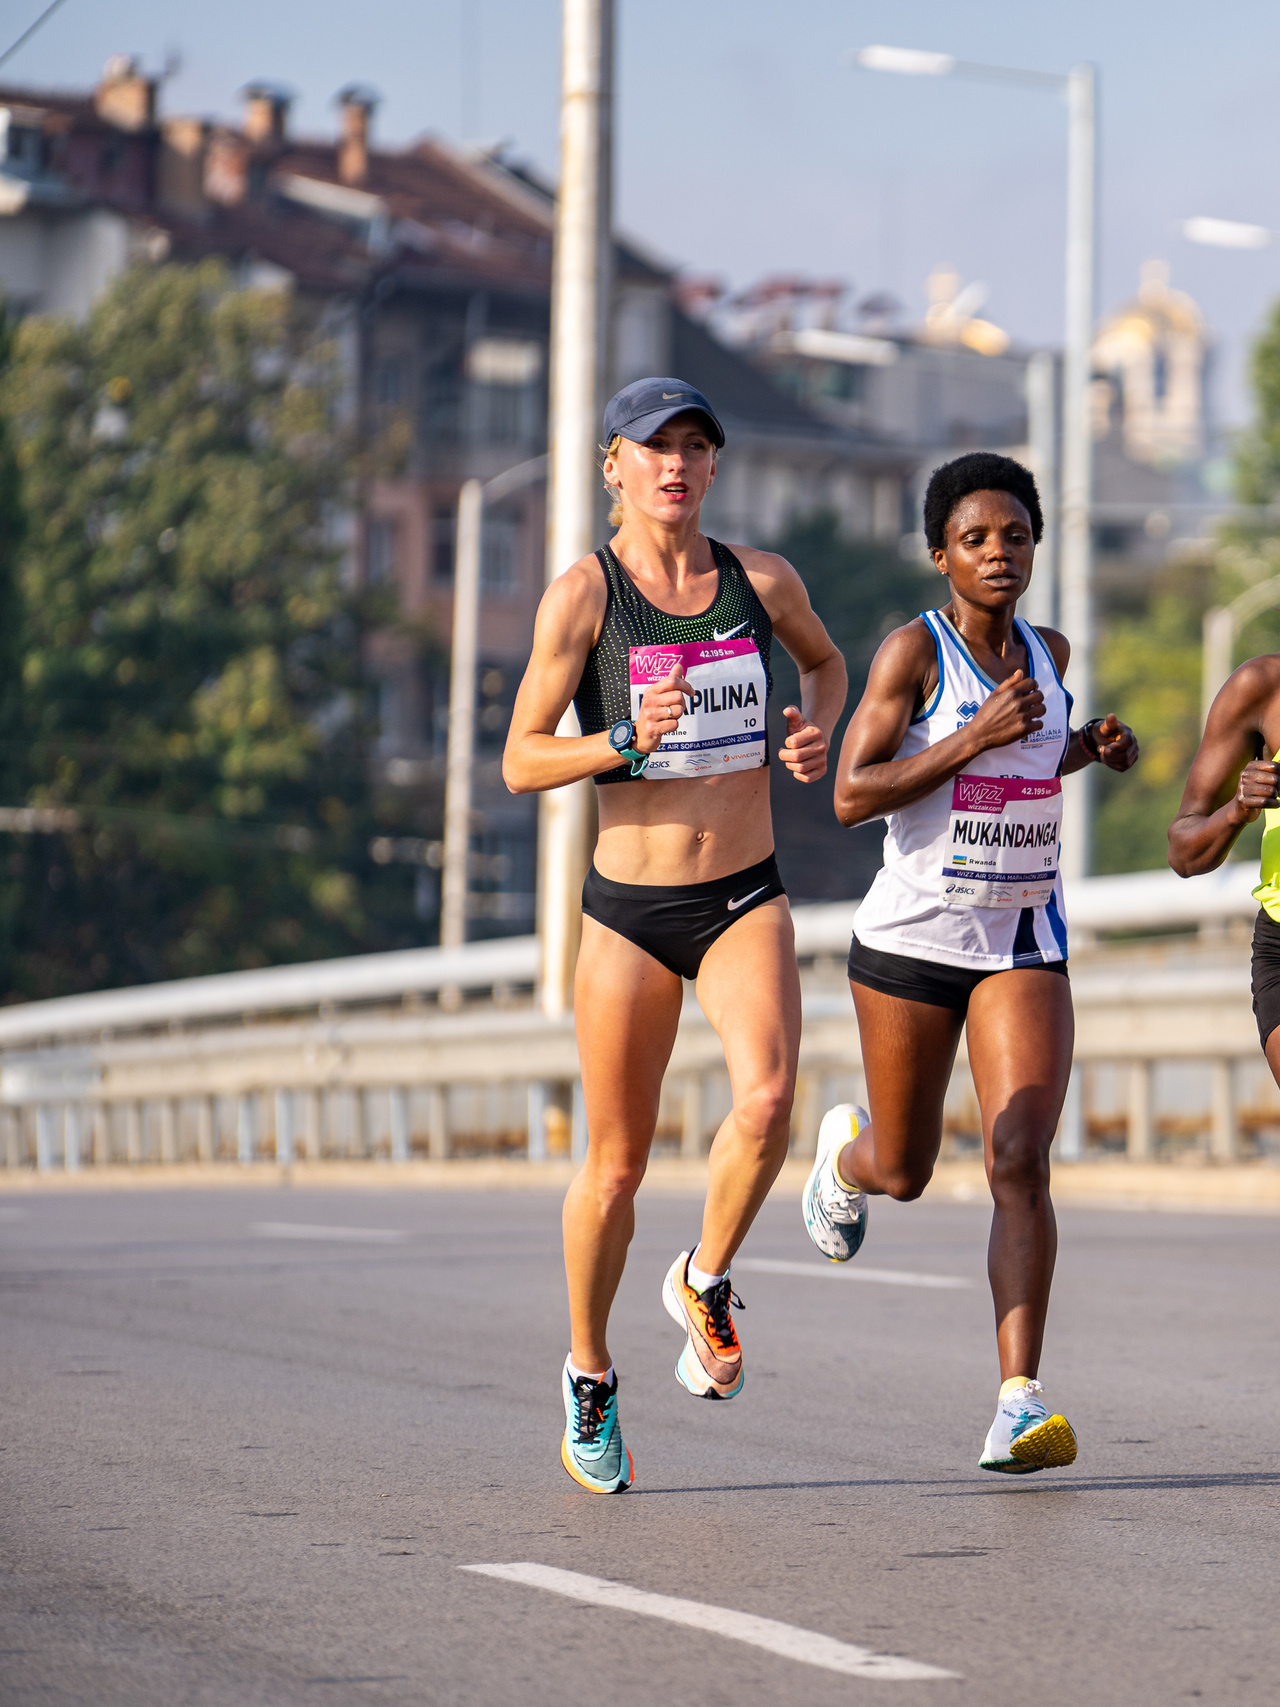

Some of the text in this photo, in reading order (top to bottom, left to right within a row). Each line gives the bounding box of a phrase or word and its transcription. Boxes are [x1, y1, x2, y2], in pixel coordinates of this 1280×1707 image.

[699, 649, 724, 658] 42.195
[639, 682, 759, 716] PILINA
[744, 718, 757, 728] 10
[1029, 728, 1062, 738] ITALIANA
[701, 738, 736, 749] MARATHON
[736, 735, 752, 743] 2020
[731, 751, 760, 760] VIVACOM
[1021, 787, 1046, 796] 42.195
[967, 804, 1003, 812] wizzair.com
[952, 819, 1057, 848] MUKANDANGA
[968, 858, 997, 867] Rwanda
[1043, 857, 1053, 867] 15
[975, 872, 987, 880] AIR
